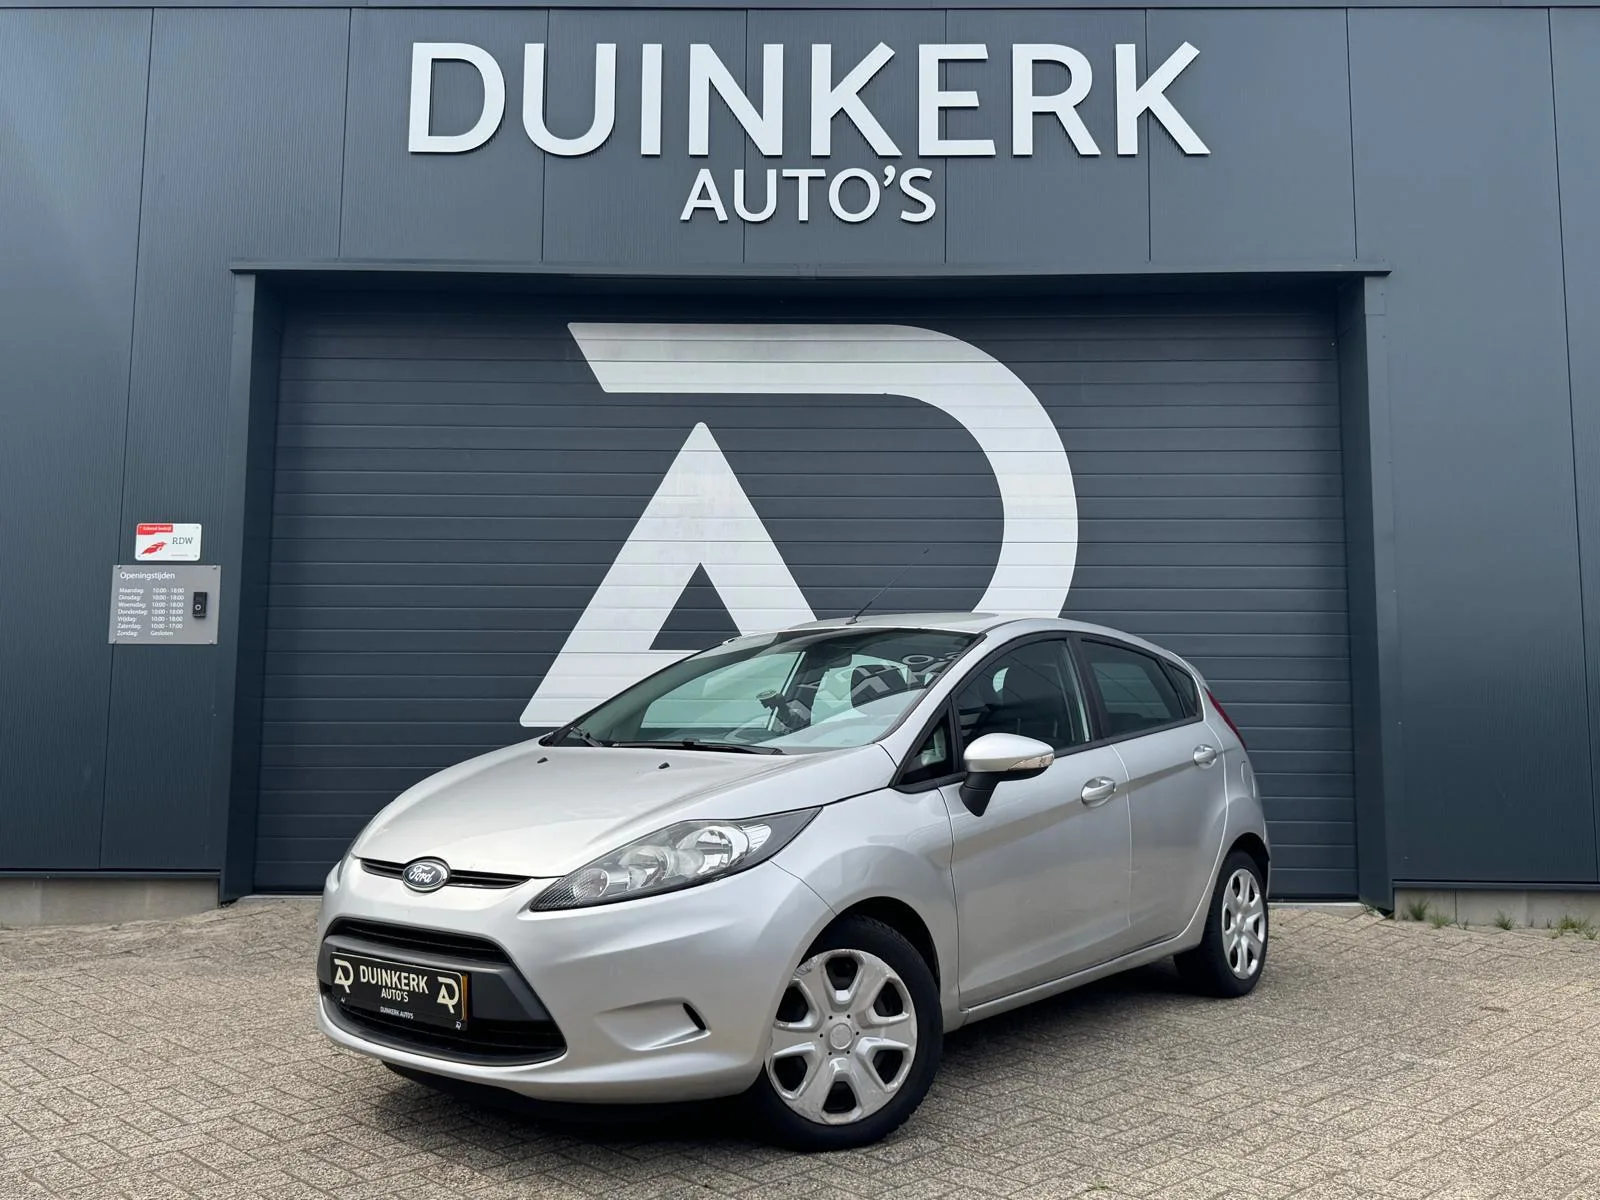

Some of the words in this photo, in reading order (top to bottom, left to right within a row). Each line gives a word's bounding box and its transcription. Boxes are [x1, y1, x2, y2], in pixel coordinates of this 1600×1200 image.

[407, 41, 1211, 157] DUINKERK
[680, 164, 937, 223] AUTO'S
[172, 536, 193, 545] RDW
[120, 571, 175, 581] Openingstijden
[409, 865, 435, 883] Ford
[359, 965, 429, 994] DUINKERK
[381, 987, 409, 1003] AUTO'S
[380, 1006, 399, 1016] DUINKERK
